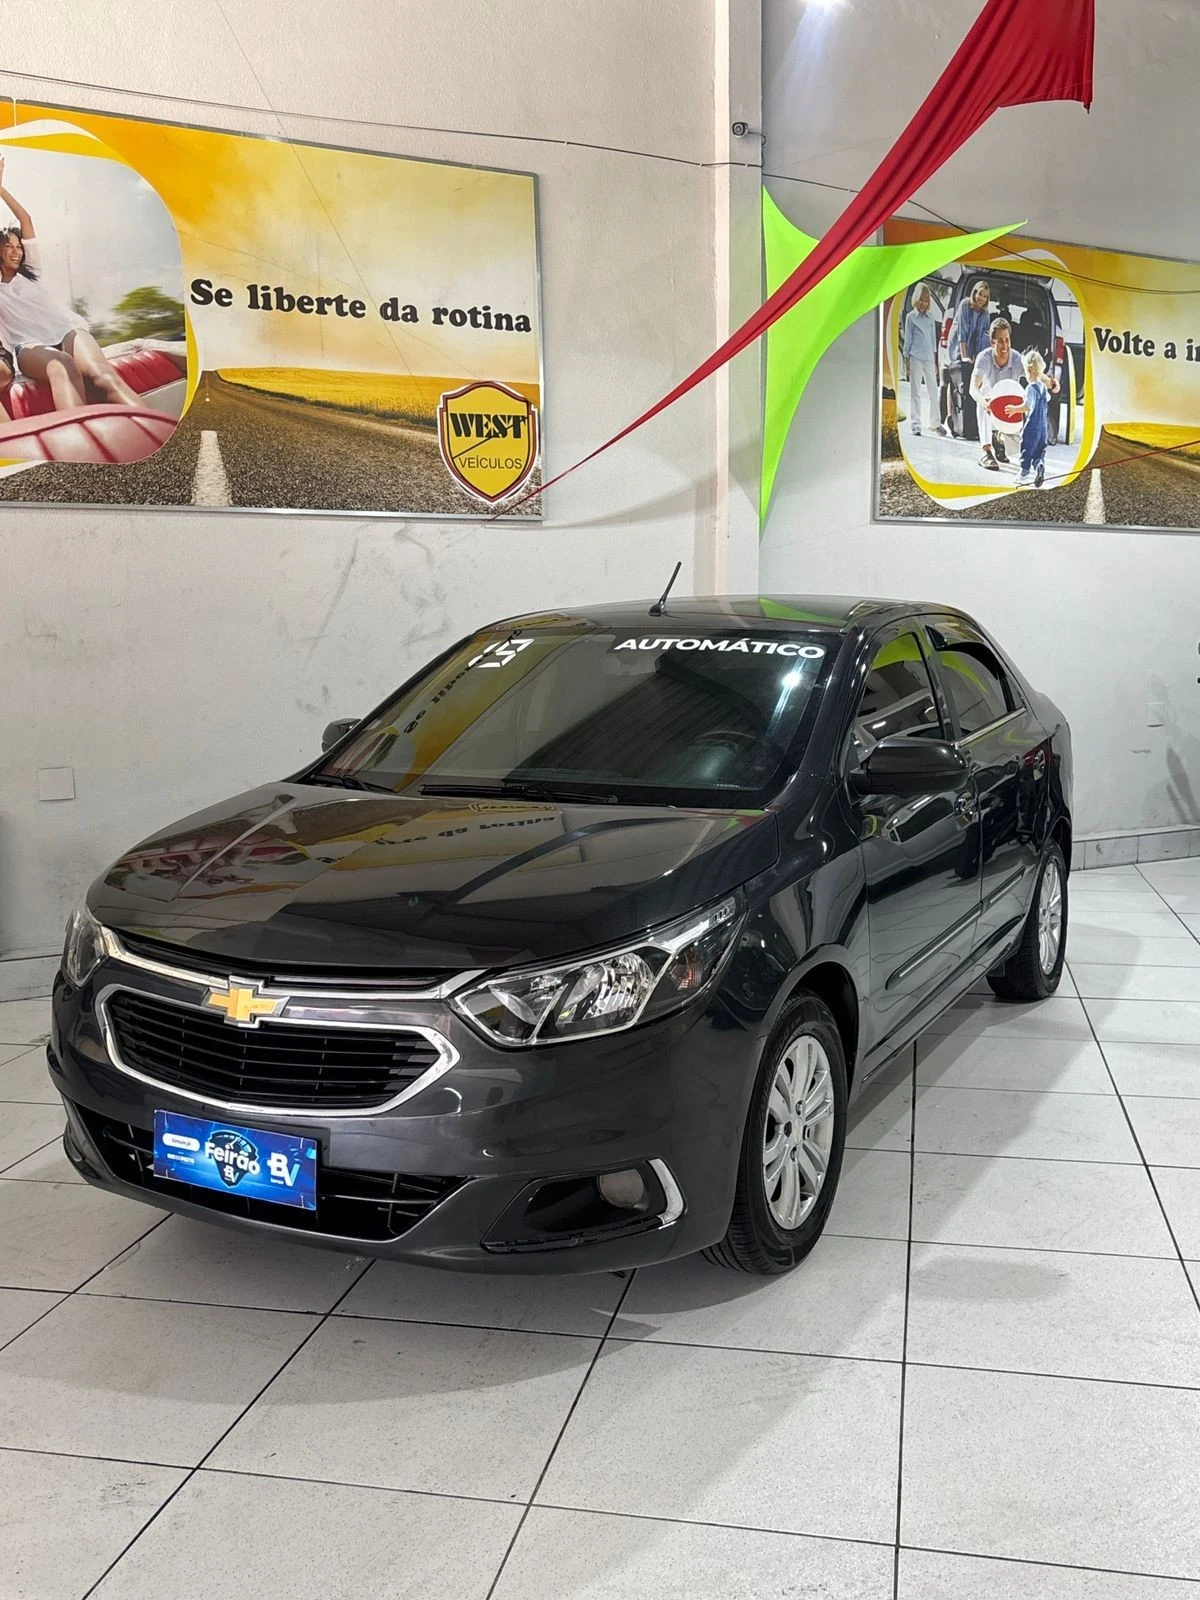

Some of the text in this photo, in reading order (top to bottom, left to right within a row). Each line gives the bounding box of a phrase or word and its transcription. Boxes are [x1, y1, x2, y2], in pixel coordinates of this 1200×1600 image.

[190, 278, 531, 333] Se liberte da rotina
[1093, 327, 1155, 357] Volte
[1163, 341, 1177, 360] a
[449, 412, 528, 439] WEST
[458, 455, 522, 470] VEÍCULOS
[614, 637, 825, 659] AUTOMÁTICO
[204, 1141, 261, 1175] Feirão
[267, 1152, 300, 1187] BV
